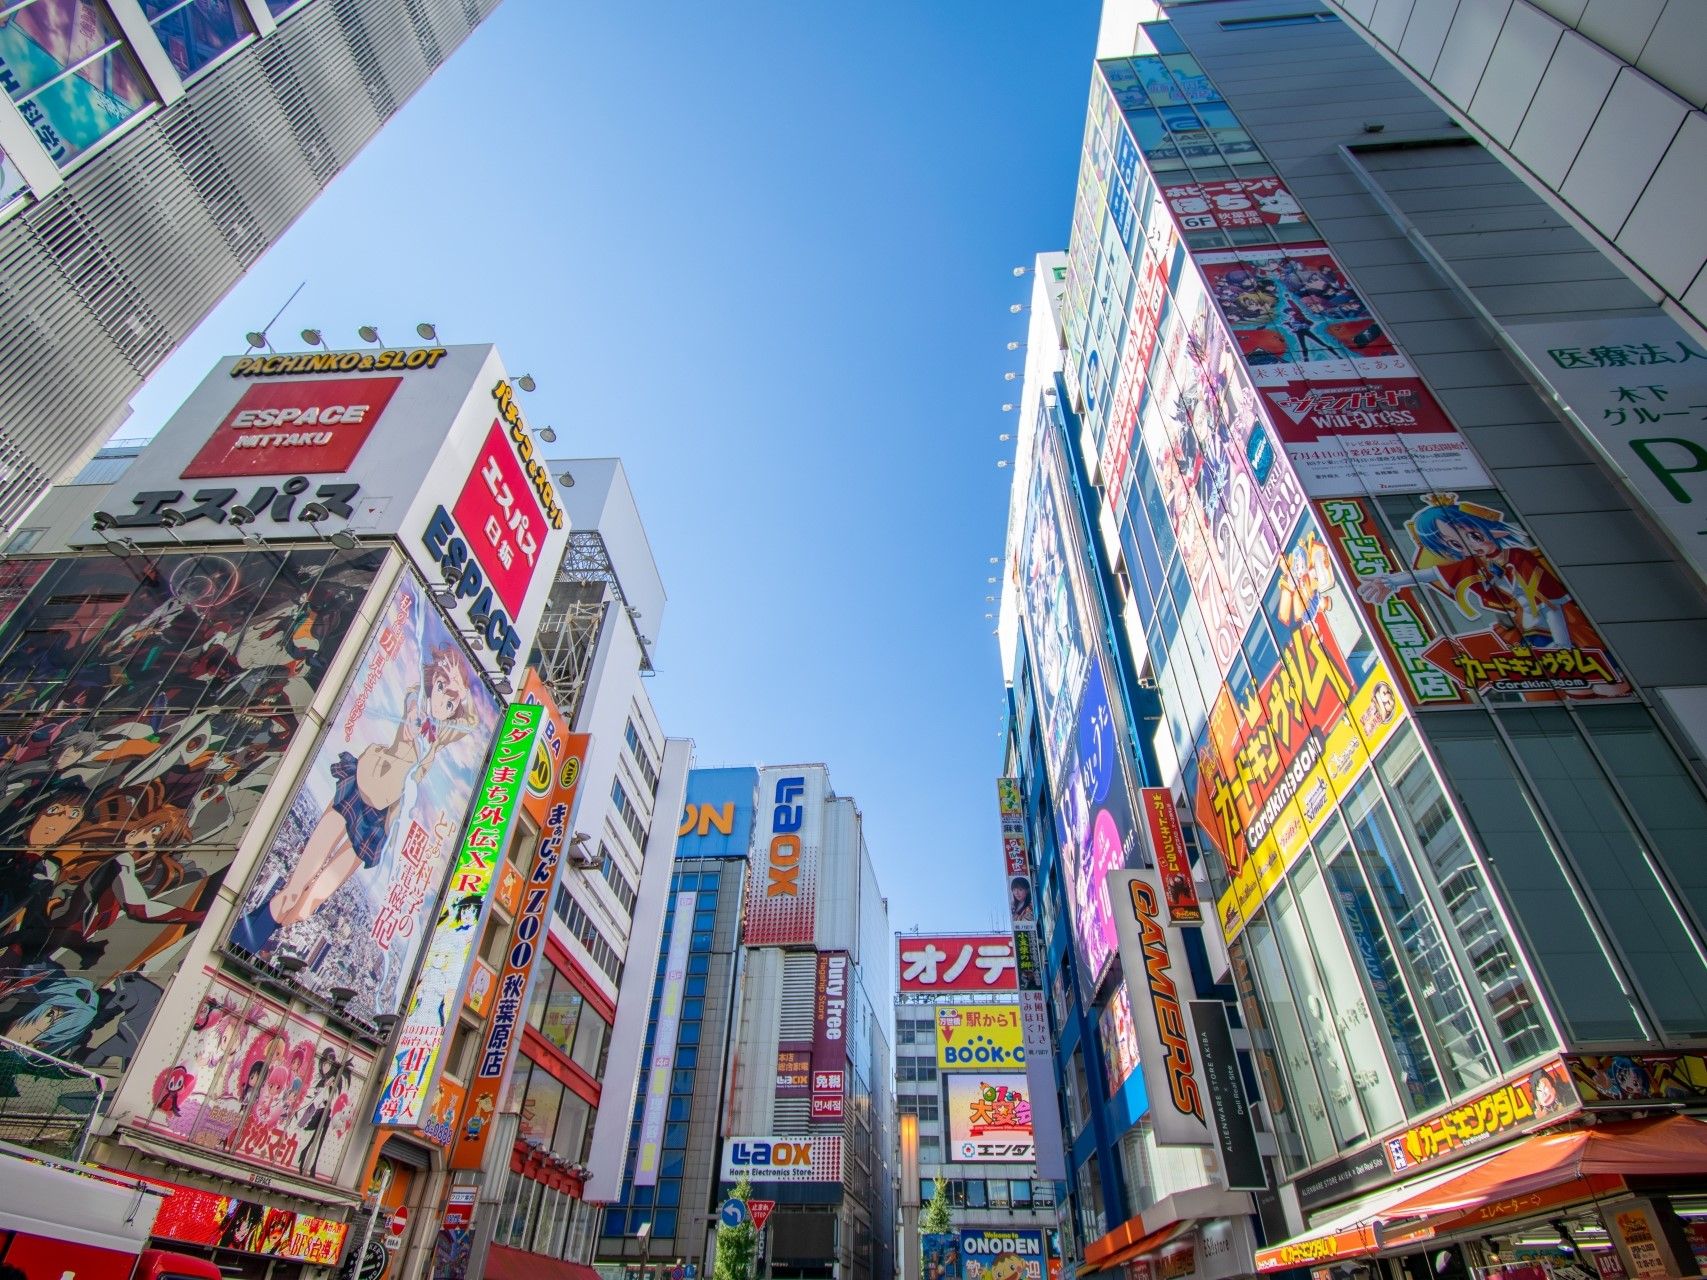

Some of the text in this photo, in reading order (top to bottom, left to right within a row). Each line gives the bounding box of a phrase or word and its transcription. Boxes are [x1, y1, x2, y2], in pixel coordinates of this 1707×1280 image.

[1184, 215, 1211, 228] 6F
[1548, 340, 1707, 370] 医療法人
[1610, 384, 1669, 404] 木下
[231, 405, 370, 430] ESPACE
[234, 431, 333, 450] NITTAKU
[115, 476, 361, 528] エスパス
[481, 455, 537, 567] エスパス
[422, 505, 521, 663] ESPACE
[1322, 500, 1459, 700] カードゲム専門店
[1455, 647, 1615, 687] カードキングダム
[510, 888, 549, 970] ZOO
[818, 957, 828, 1020] Flagship Store
[826, 957, 846, 1040] Duty Free
[1128, 878, 1208, 1130] GAMERS
[480, 974, 526, 1078] 秋葉原店
[1227, 1064, 1236, 1081] Site
[1201, 1031, 1233, 1153] ALIENWARE STORE AKIBA
[1232, 1081, 1240, 1099] Real
[814, 1100, 842, 1112] 면세점
[1419, 1085, 1535, 1157] カードキングダム
[977, 1144, 1036, 1156] エンタ
[752, 1168, 790, 1177] Electronics
[792, 1168, 812, 1176] Store
[751, 1203, 769, 1211] 止まれ
[1480, 1199, 1529, 1219] エレベーター
[963, 1237, 1040, 1255] ONODEN
